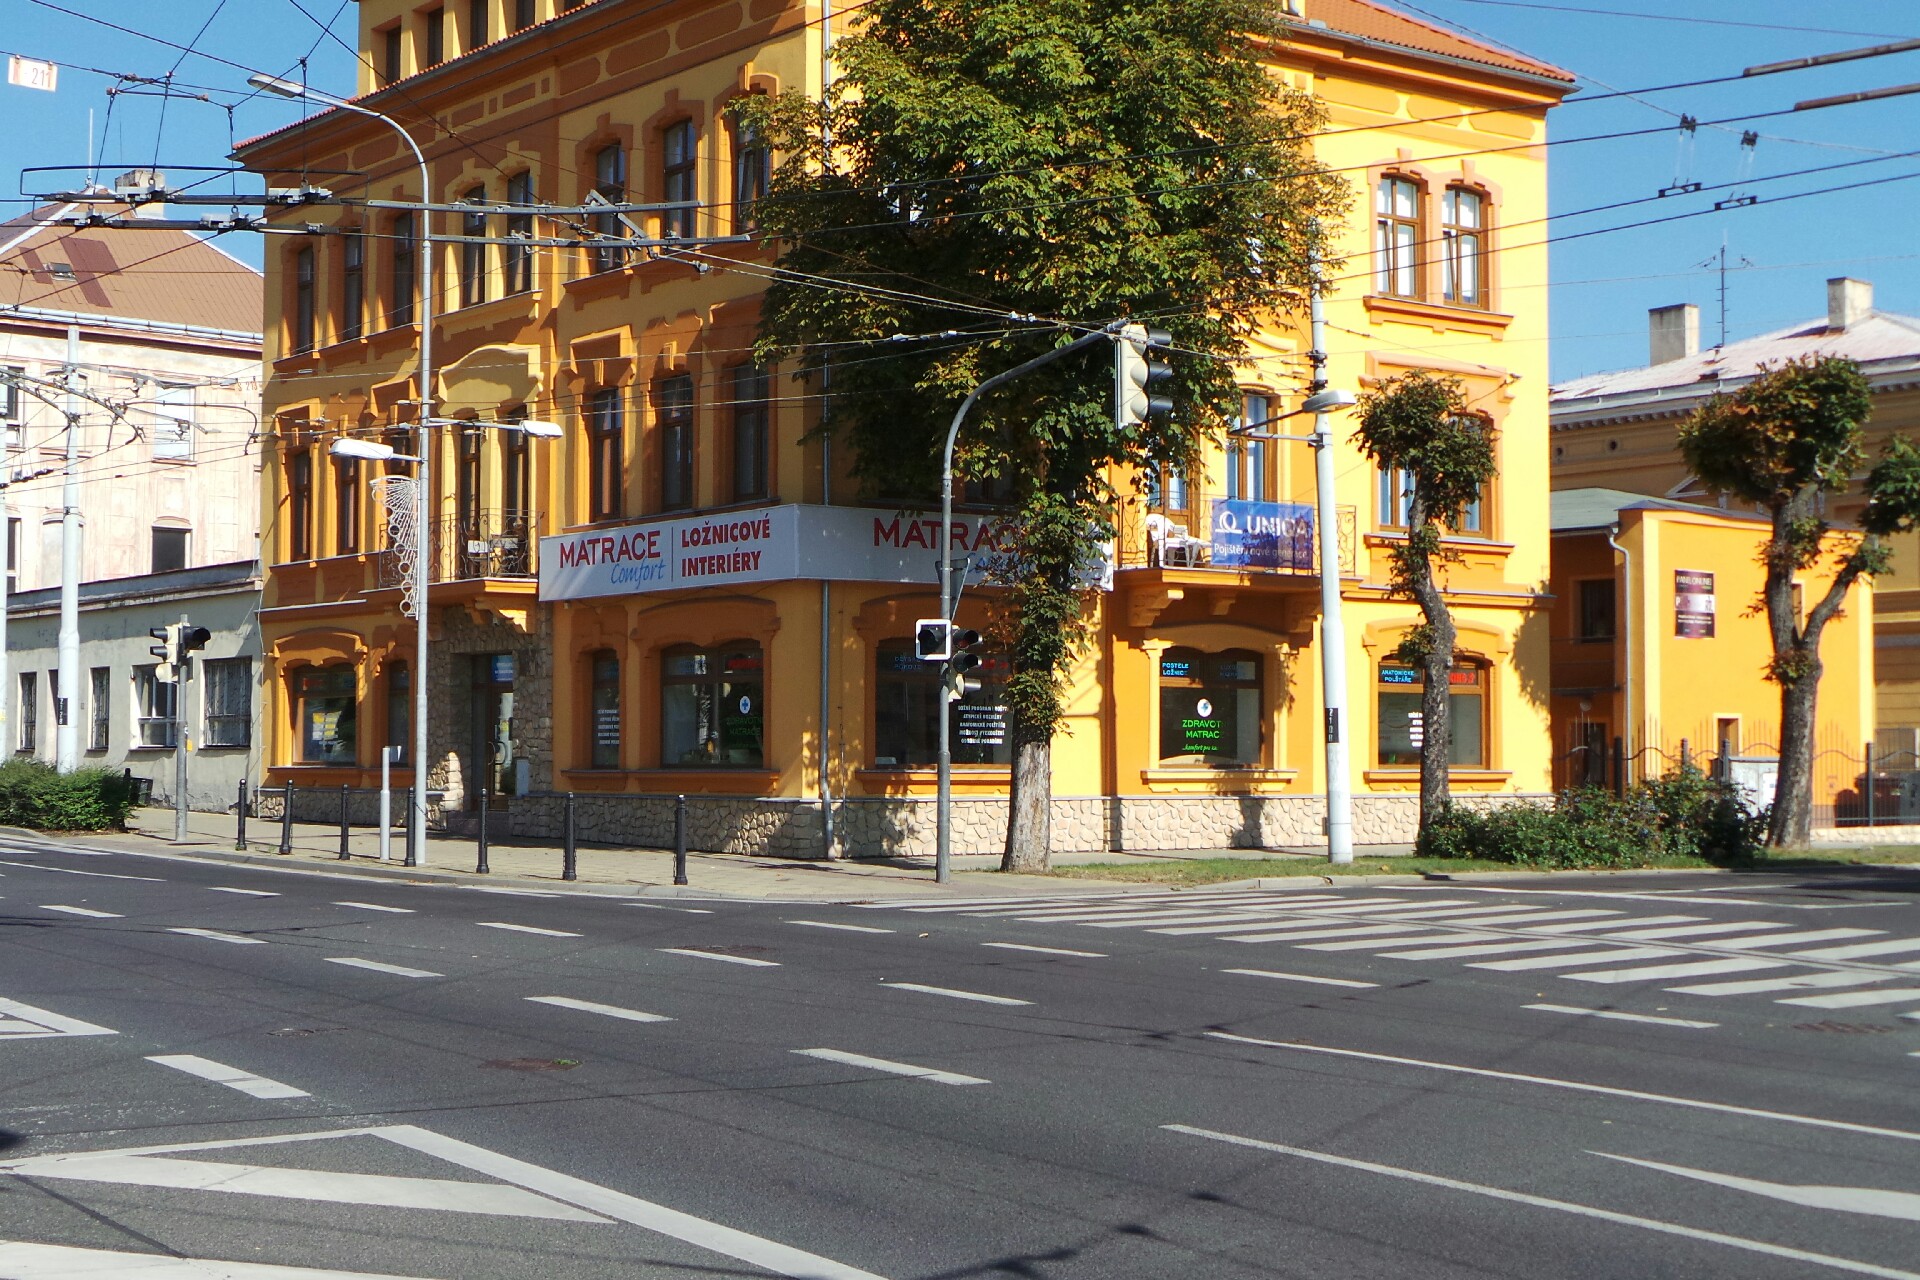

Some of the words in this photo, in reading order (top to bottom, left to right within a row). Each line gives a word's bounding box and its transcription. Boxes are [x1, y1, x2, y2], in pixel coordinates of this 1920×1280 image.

[680, 512, 771, 548] LOŽNICOVÉ
[873, 518, 1018, 553] MATRAC
[559, 529, 661, 569] MATRACE
[681, 547, 762, 577] INTERIÉRY
[610, 556, 667, 590] Comfort
[1182, 719, 1221, 728] ZDRAVOT
[1185, 730, 1220, 739] MATRAC
